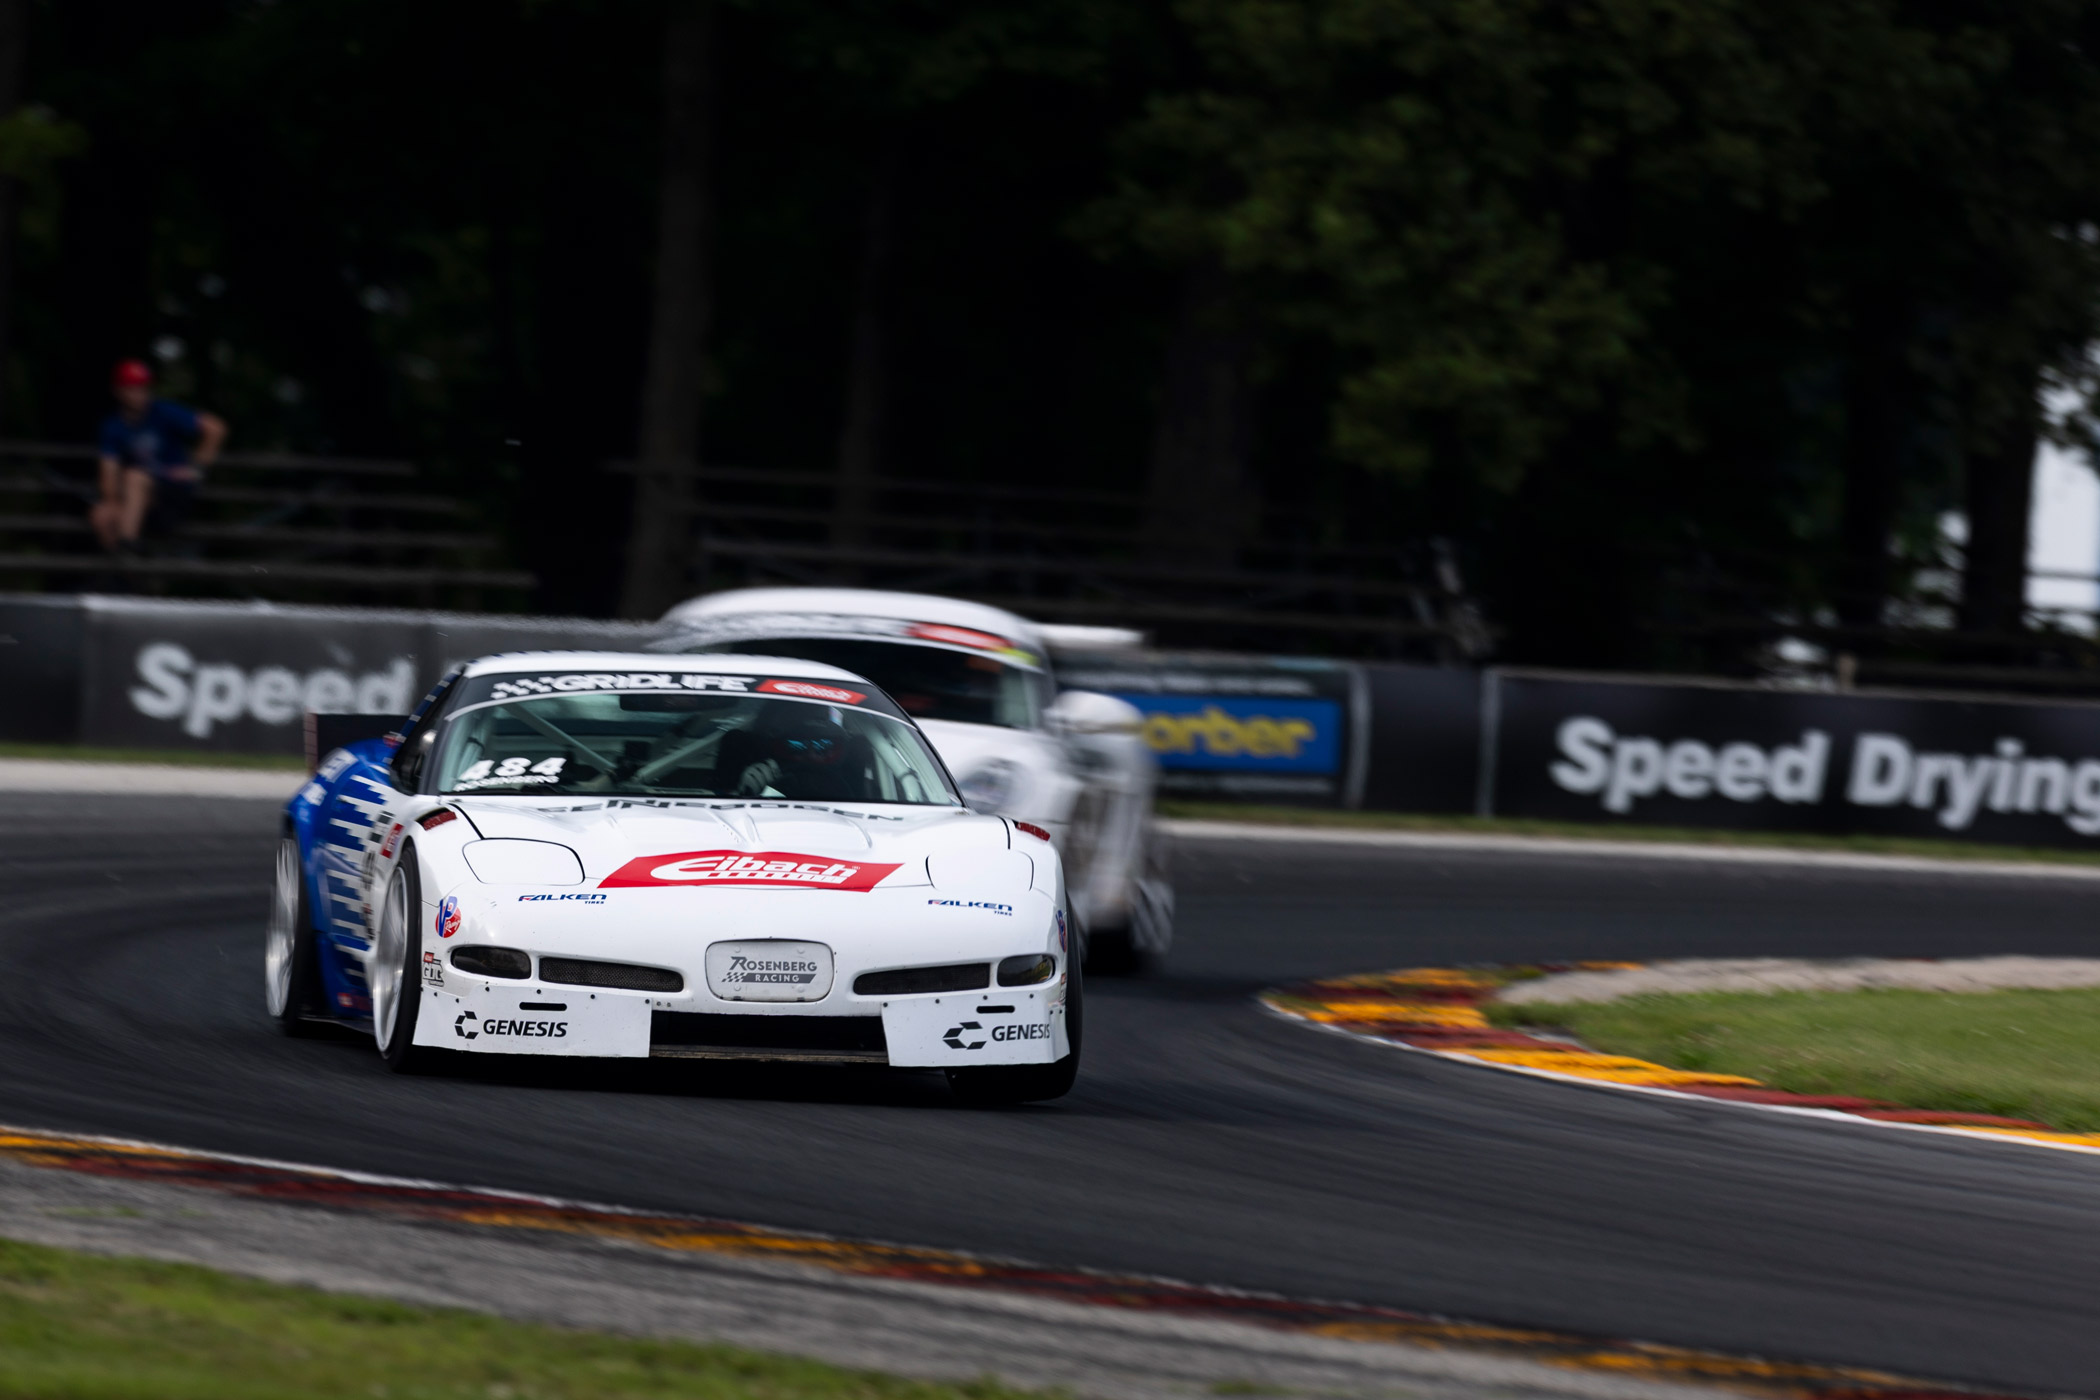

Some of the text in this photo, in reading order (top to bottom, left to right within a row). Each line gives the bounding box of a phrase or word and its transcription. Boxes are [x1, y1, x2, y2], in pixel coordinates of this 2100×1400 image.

[130, 643, 416, 739] Speed
[552, 673, 757, 691] GRIDLIFE
[458, 757, 567, 780] 484
[1551, 715, 1831, 814] Speed
[650, 855, 857, 884] Eibach
[928, 899, 1012, 911] FALKEN
[729, 956, 817, 972] ROSENBERG
[755, 974, 800, 983] RACING
[483, 1019, 568, 1037] GENESIS
[991, 1024, 1050, 1042] GENESIS
